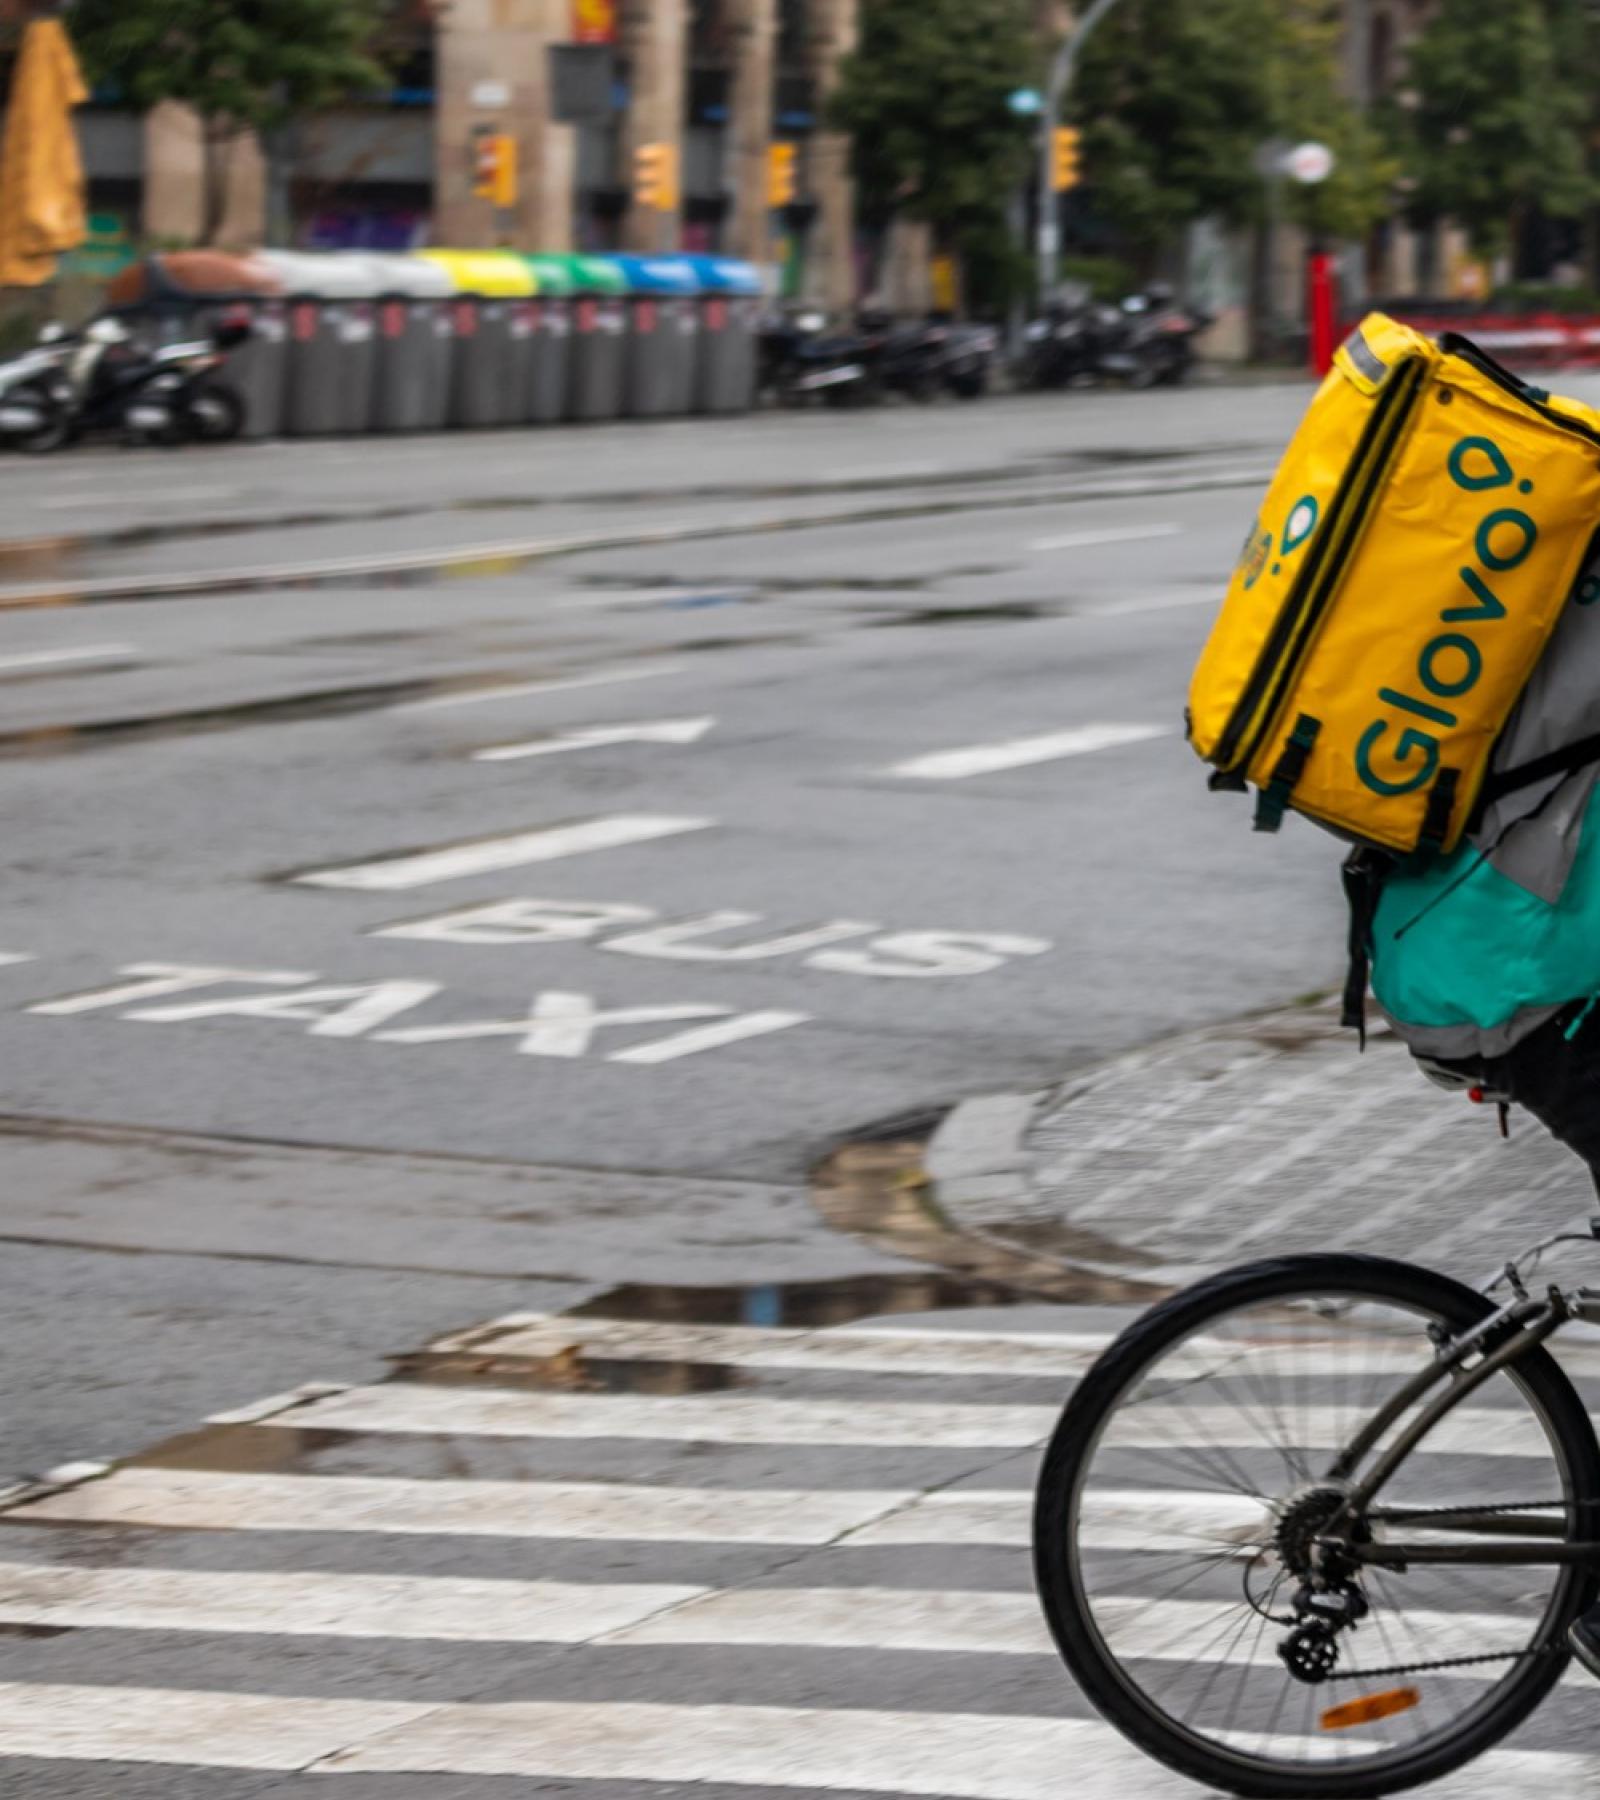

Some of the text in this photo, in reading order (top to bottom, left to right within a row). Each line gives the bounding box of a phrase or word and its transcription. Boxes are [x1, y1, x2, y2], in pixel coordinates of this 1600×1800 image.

[1355, 508, 1537, 797] Glovo
[367, 898, 1055, 977] BUS
[26, 962, 812, 1063] TAXI
